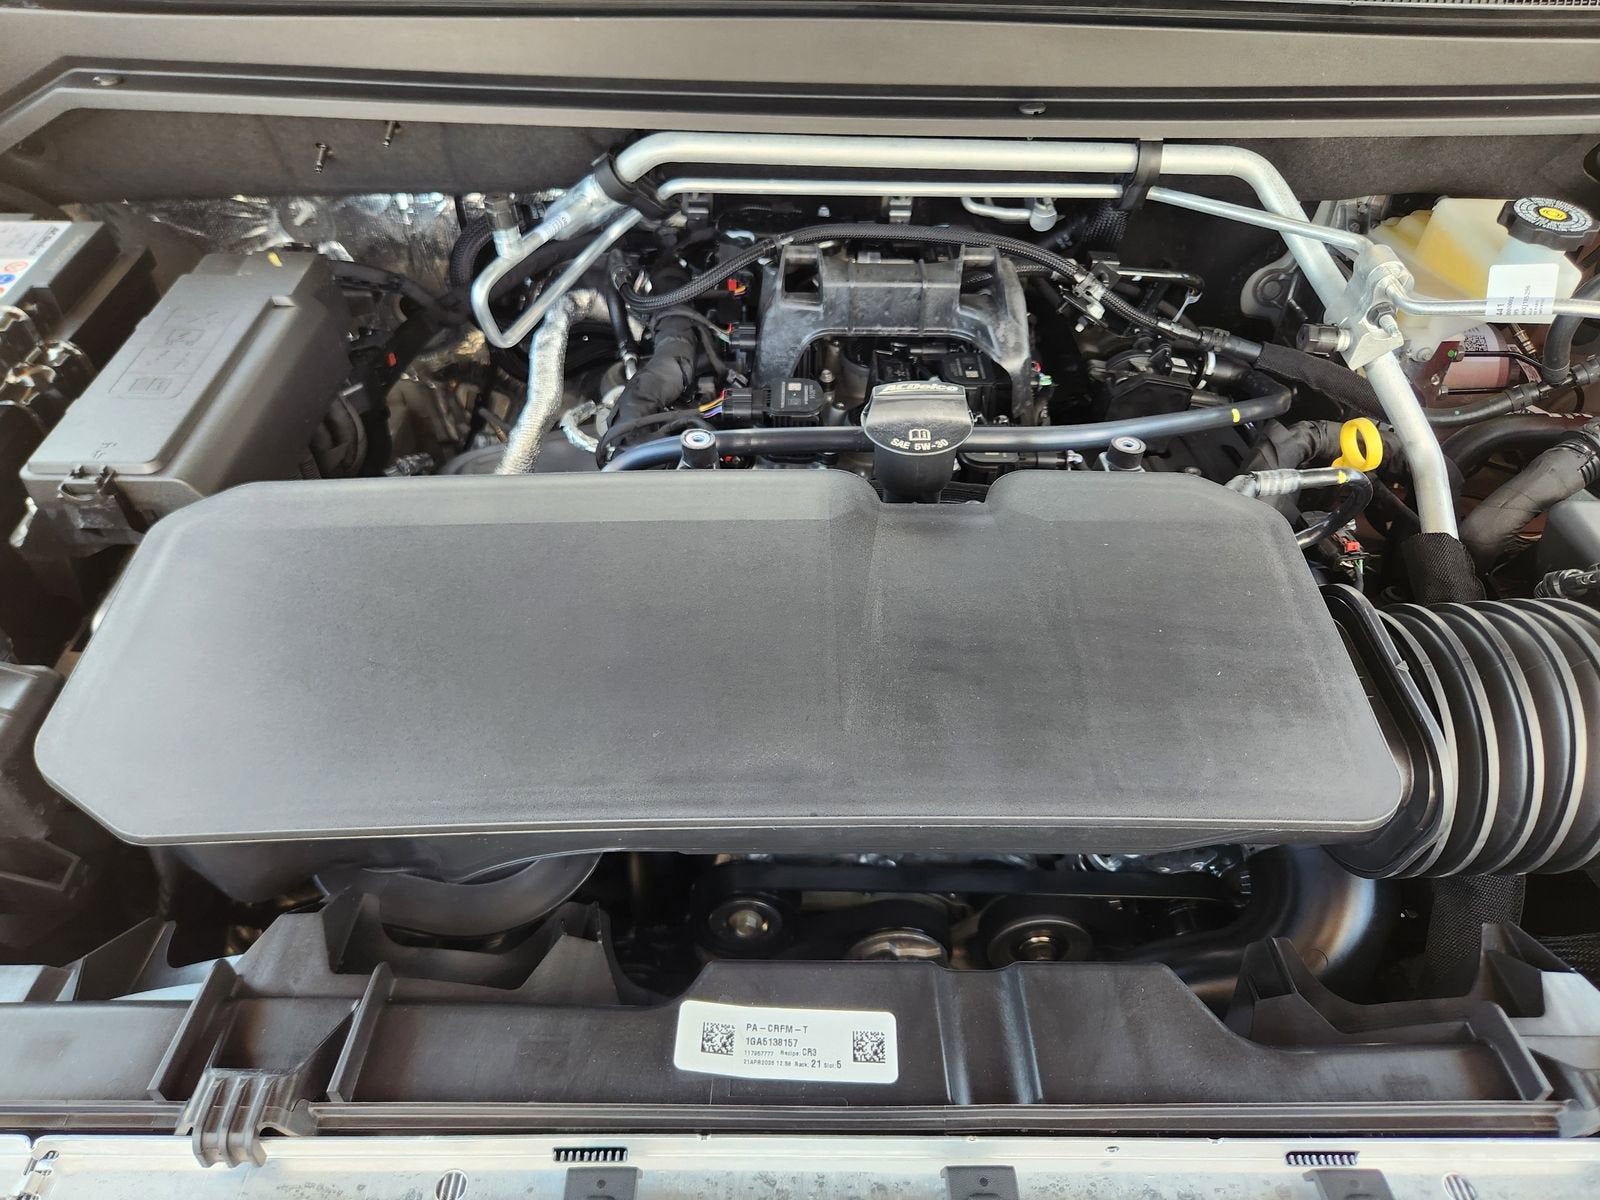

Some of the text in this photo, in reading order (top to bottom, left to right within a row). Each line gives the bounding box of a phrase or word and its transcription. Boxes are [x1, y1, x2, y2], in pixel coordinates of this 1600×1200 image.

[879, 383, 958, 395] ACDelco
[890, 438, 949, 451] SAE 5W-30
[746, 1037, 798, 1047] 1GA5138157
[802, 1048, 817, 1057] CR3
[811, 1059, 821, 1069] 21
[836, 1060, 842, 1069] 5
